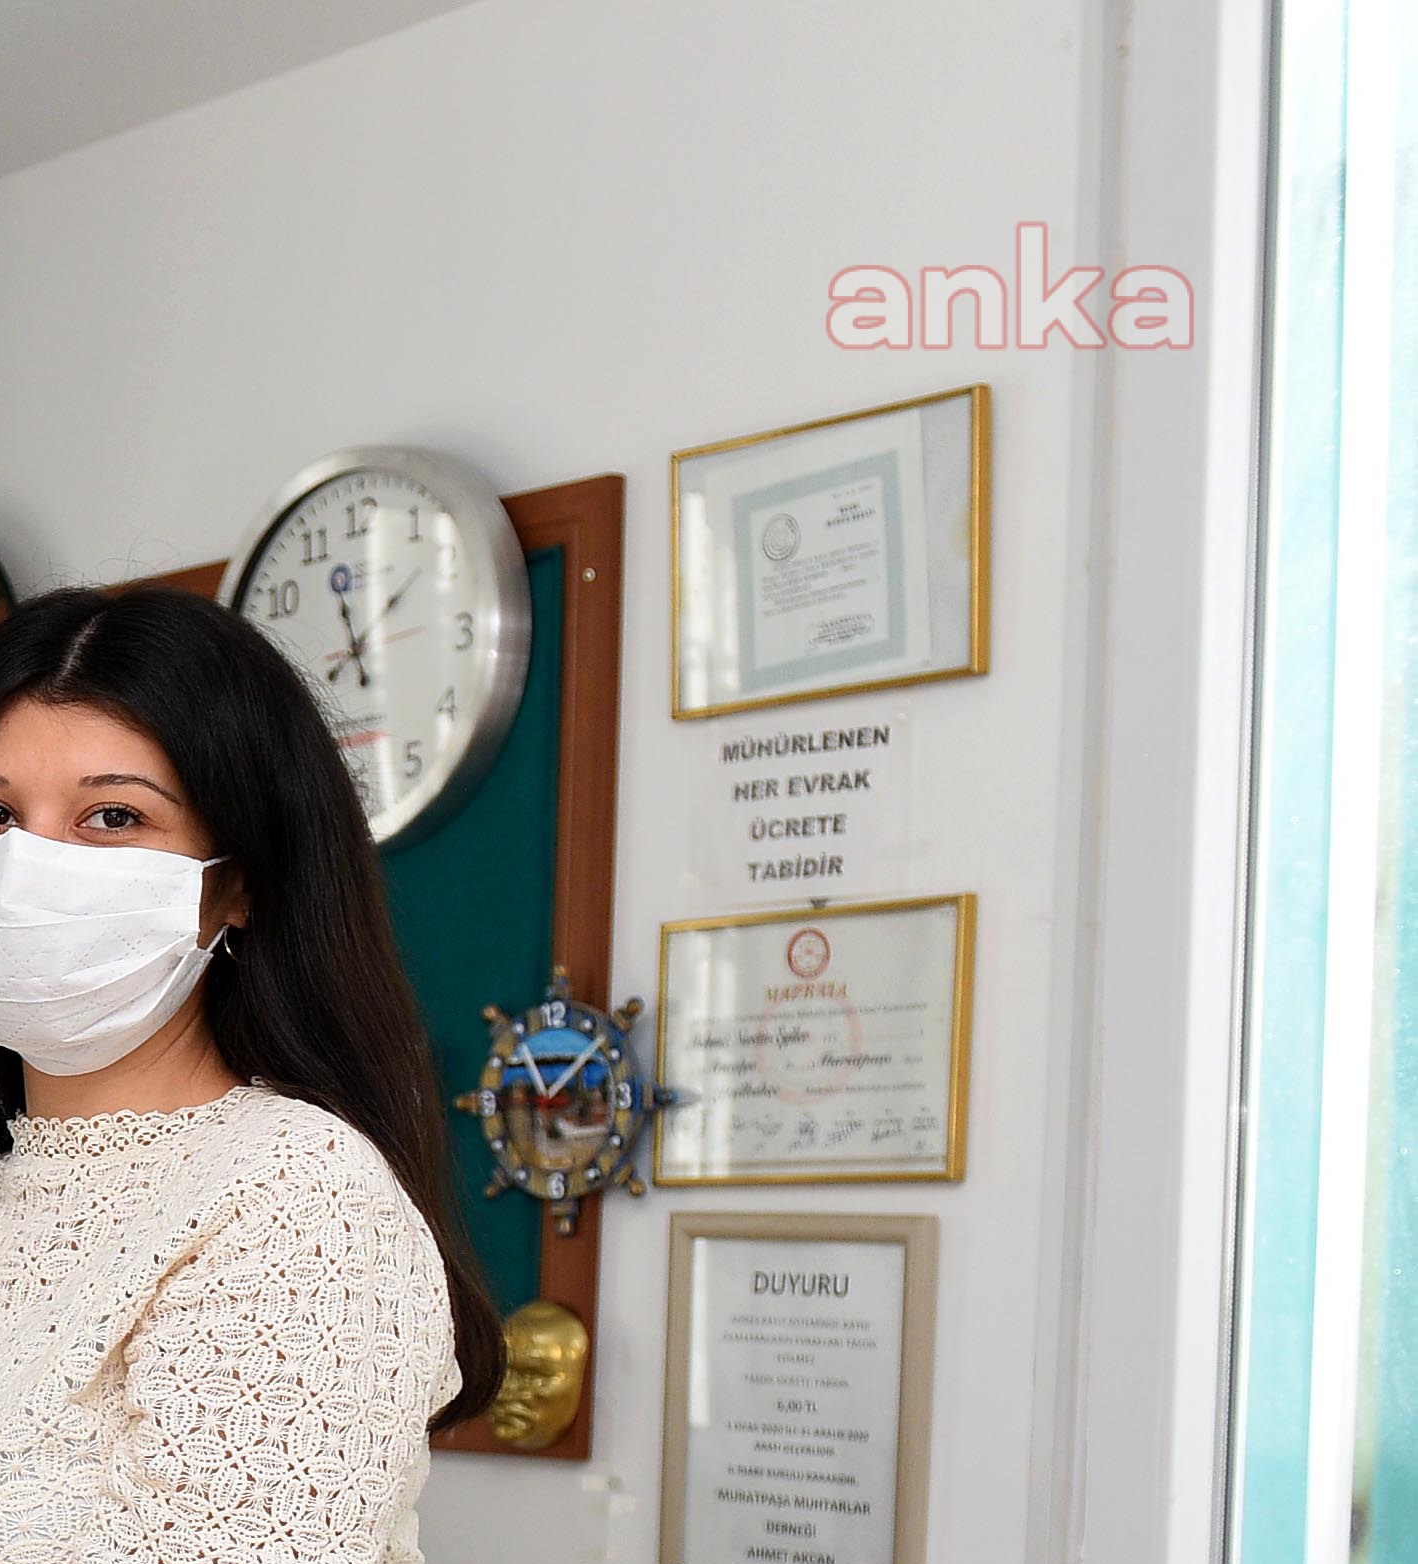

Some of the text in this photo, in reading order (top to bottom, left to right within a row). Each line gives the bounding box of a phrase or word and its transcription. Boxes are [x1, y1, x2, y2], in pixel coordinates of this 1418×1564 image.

[301, 527, 328, 566] 11
[267, 579, 300, 620] 10
[454, 611, 474, 652] 3
[721, 725, 891, 763] MÜHÜRLENEN
[404, 740, 423, 780] 5
[733, 769, 871, 801] HER EVRAK
[750, 814, 847, 840] ÜCRETE
[747, 852, 844, 881] TABİDİR
[541, 1001, 565, 1027] 12
[618, 1082, 632, 1110] 3
[754, 1270, 849, 1298] DUYURU
[717, 1487, 872, 1516] MURATPAŞA MUHTARLAR
[747, 1546, 789, 1563] AHMET
